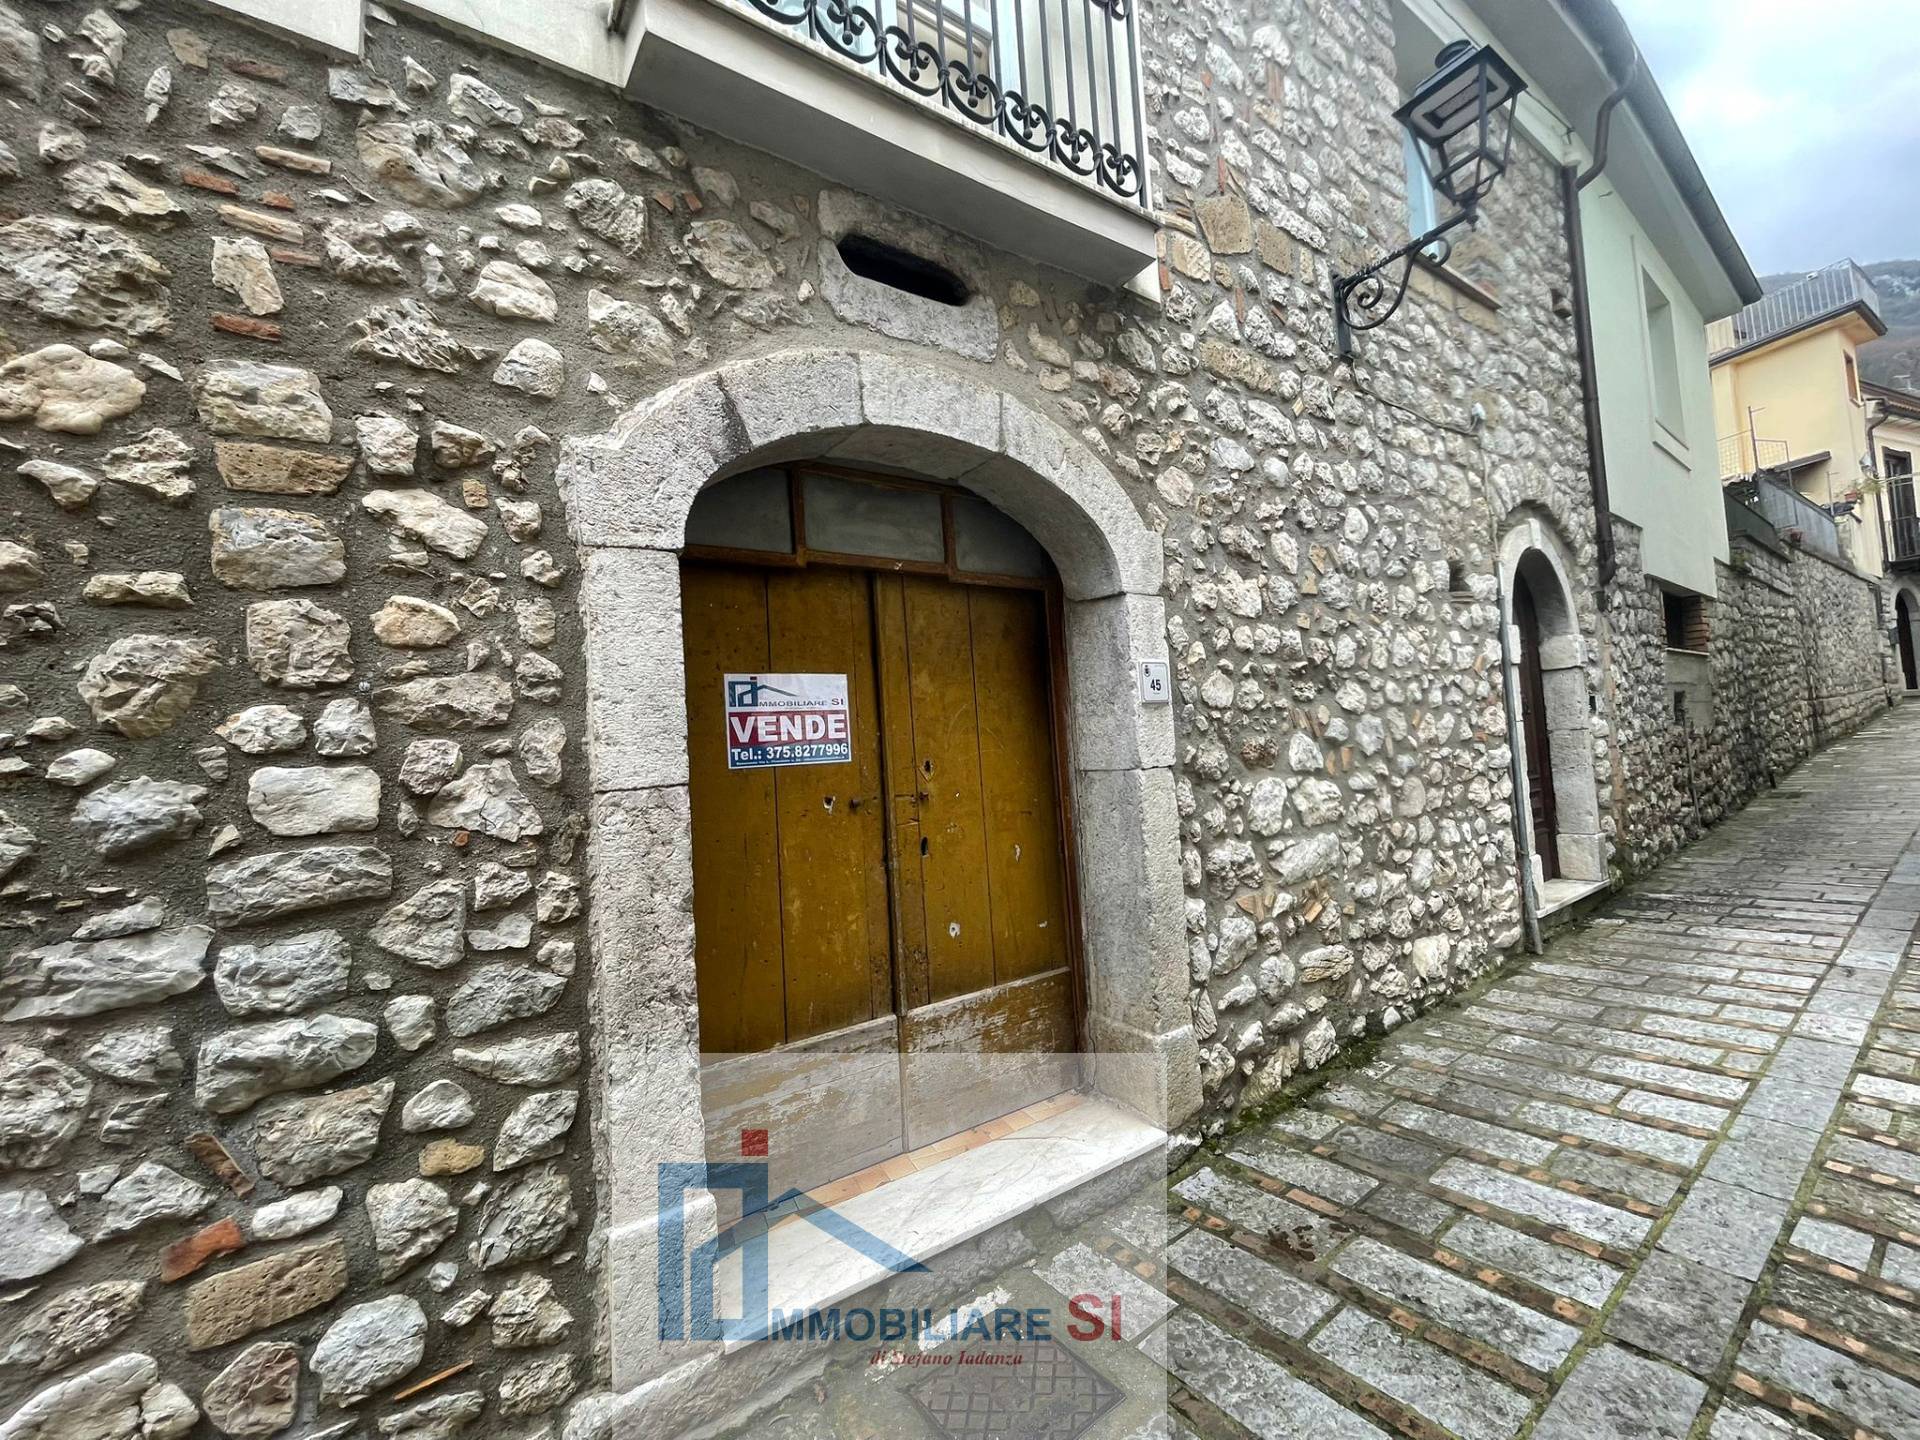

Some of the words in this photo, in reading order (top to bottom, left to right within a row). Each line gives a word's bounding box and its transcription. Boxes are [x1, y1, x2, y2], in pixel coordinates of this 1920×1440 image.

[1150, 678, 1162, 691] 45
[831, 698, 844, 706] SI
[730, 713, 847, 743] VENDE
[731, 747, 762, 761] Tel.:
[766, 743, 848, 759] 375.8277996
